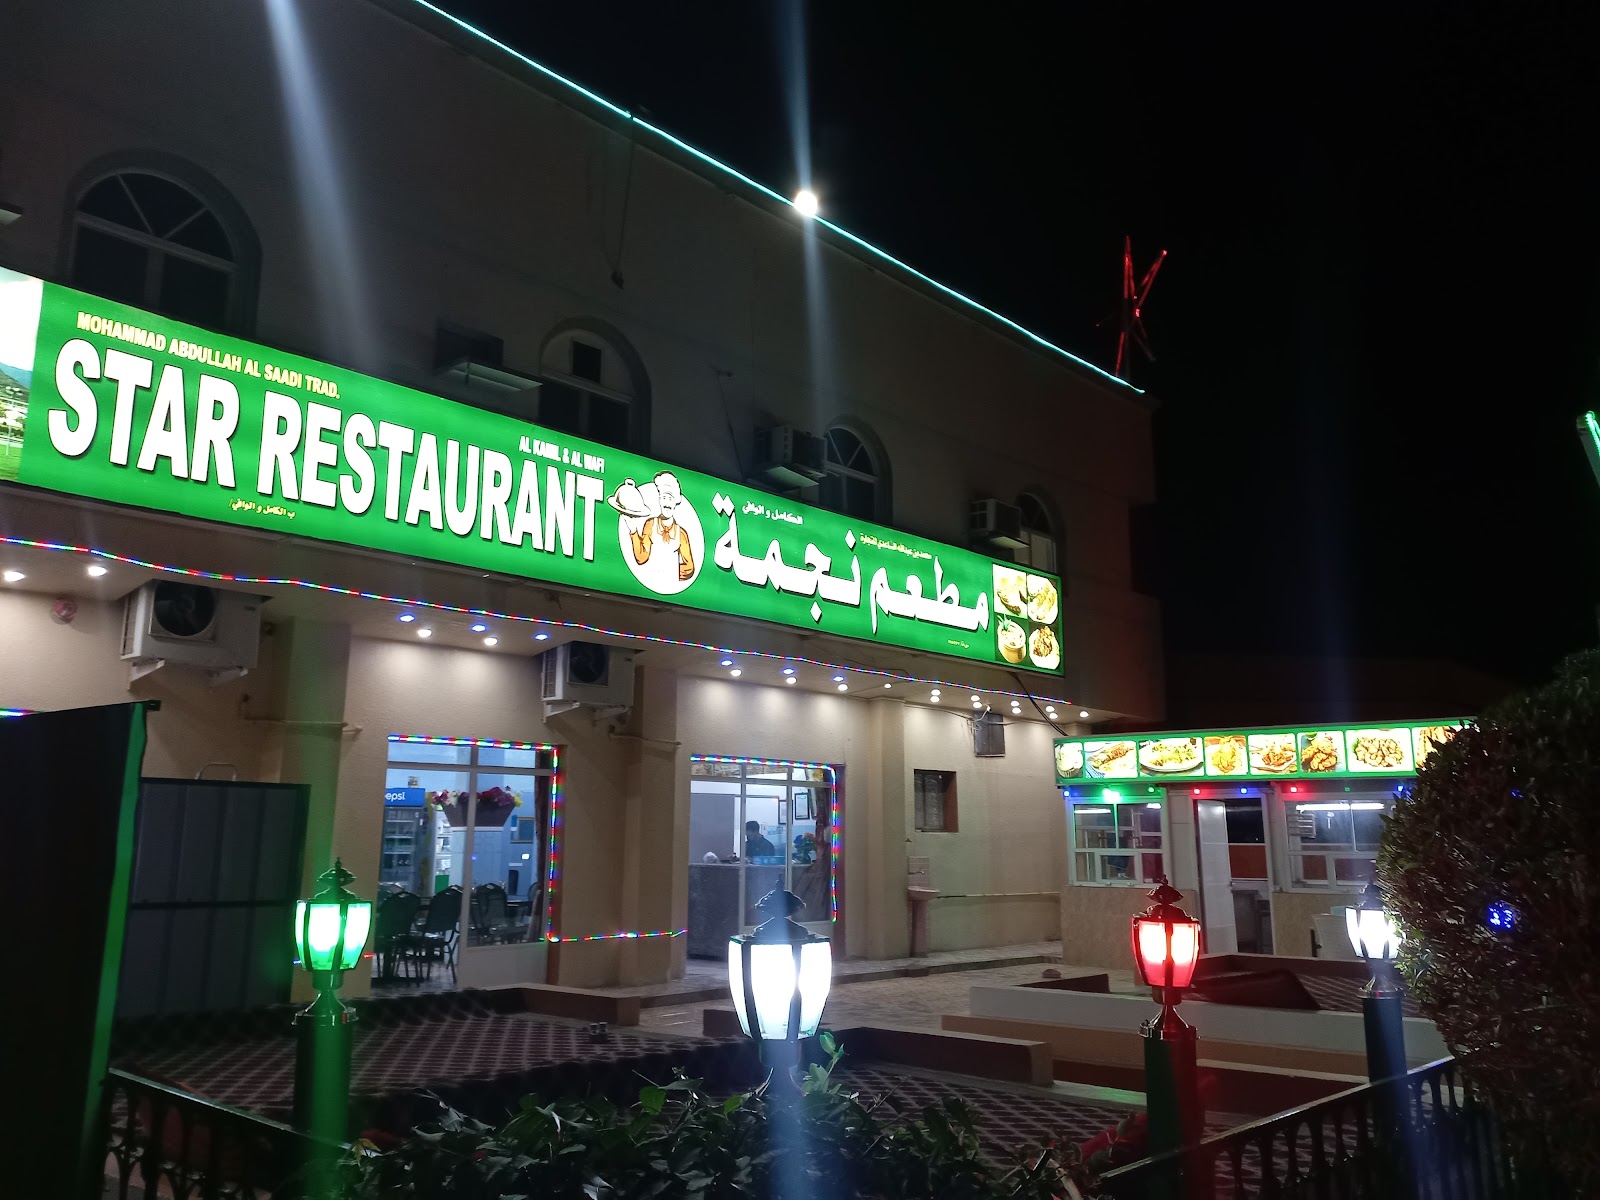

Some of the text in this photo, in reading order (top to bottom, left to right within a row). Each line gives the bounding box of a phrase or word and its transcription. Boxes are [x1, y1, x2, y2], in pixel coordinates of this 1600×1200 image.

[77, 311, 340, 399] MOHAMMAD ABDULLAH AL SAADI TRAD.
[48, 338, 604, 561] STAR RESTAURANT
[519, 435, 532, 454] AL
[562, 447, 570, 464] &
[571, 450, 583, 468] AL
[712, 491, 989, 634] مطعم نجمة
[385, 792, 405, 802] epsi
